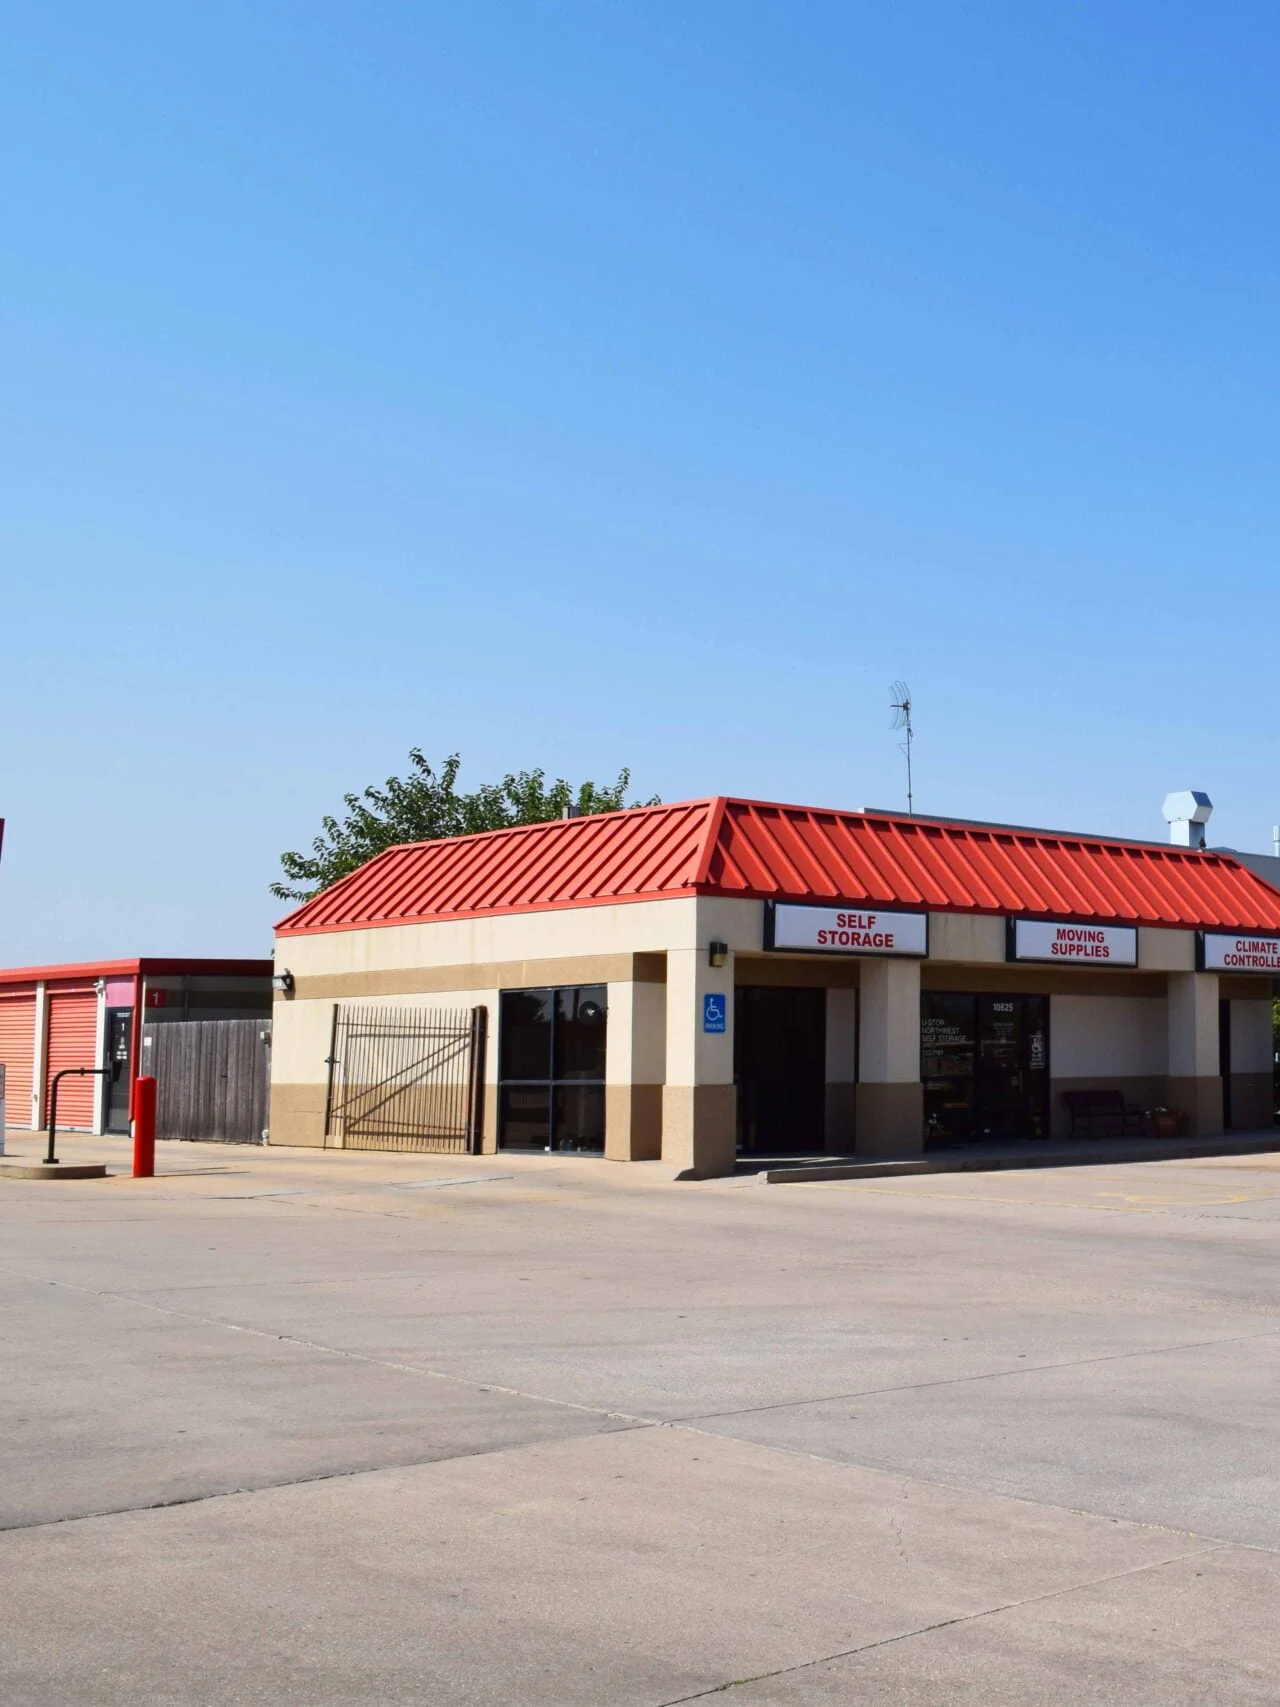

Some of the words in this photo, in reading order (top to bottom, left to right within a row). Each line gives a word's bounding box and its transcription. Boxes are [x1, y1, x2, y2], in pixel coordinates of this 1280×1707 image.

[836, 913, 876, 929] SELF
[817, 929, 894, 948] STORAGE
[1056, 928, 1105, 943] MOVING
[1051, 943, 1110, 958] SUPPLIES
[1235, 940, 1278, 954] CLIMATE
[992, 1002, 1014, 1012] 10625
